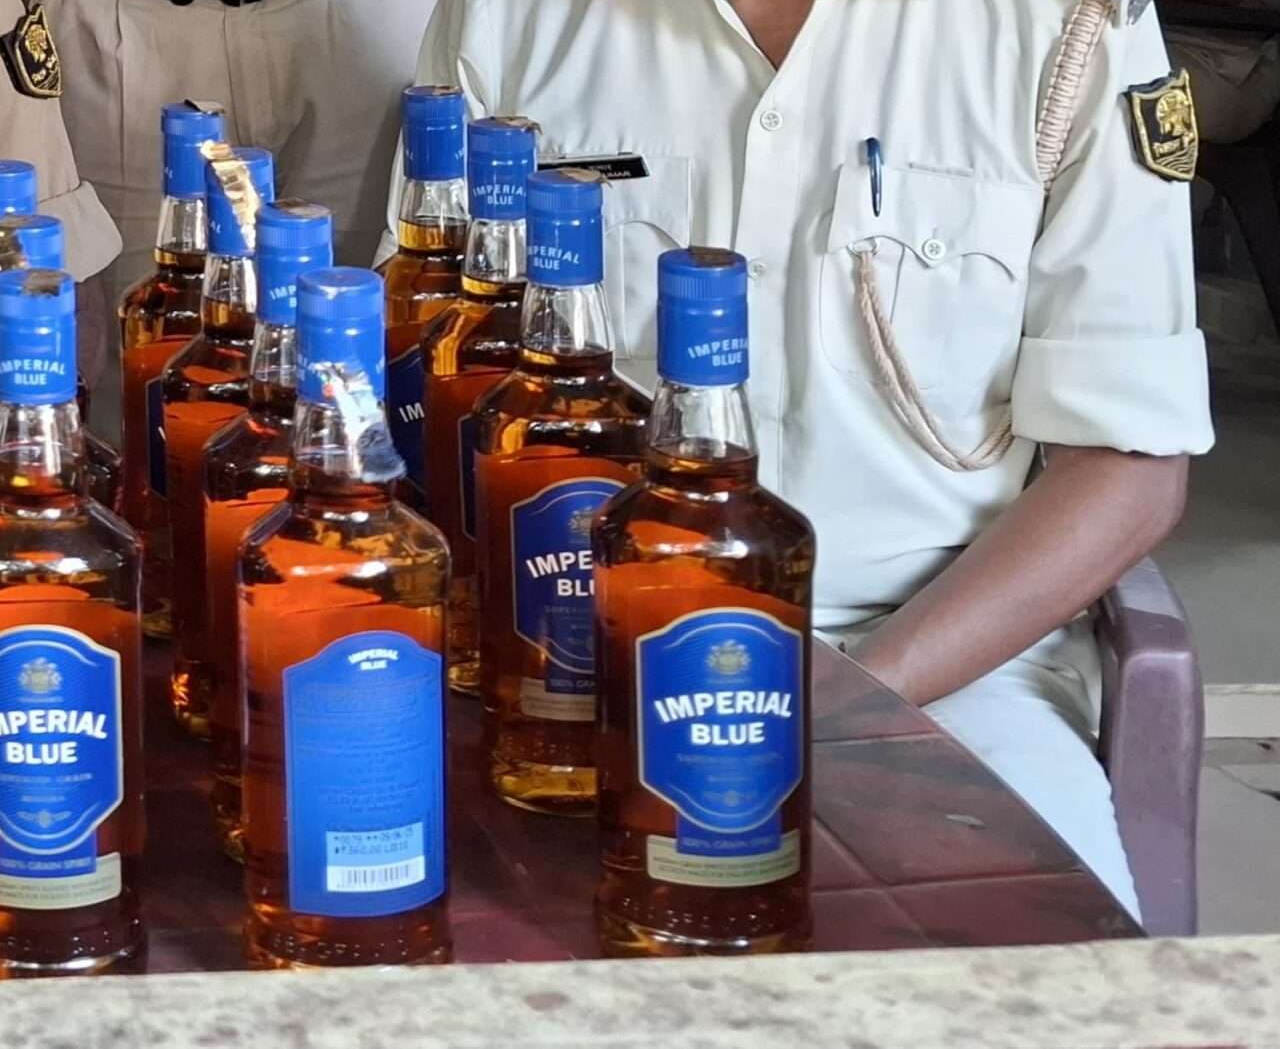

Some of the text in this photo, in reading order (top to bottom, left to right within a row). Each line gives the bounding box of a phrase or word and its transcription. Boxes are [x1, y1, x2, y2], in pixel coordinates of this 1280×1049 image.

[487, 196, 513, 206] BLUE
[533, 258, 561, 271] BLUE
[711, 351, 743, 367] BLUE
[14, 372, 48, 386] BLUE
[526, 550, 593, 579] IMPE
[653, 690, 793, 723] IMPERIAL
[690, 721, 766, 746] BLUE
[5, 741, 79, 765] BLUE
